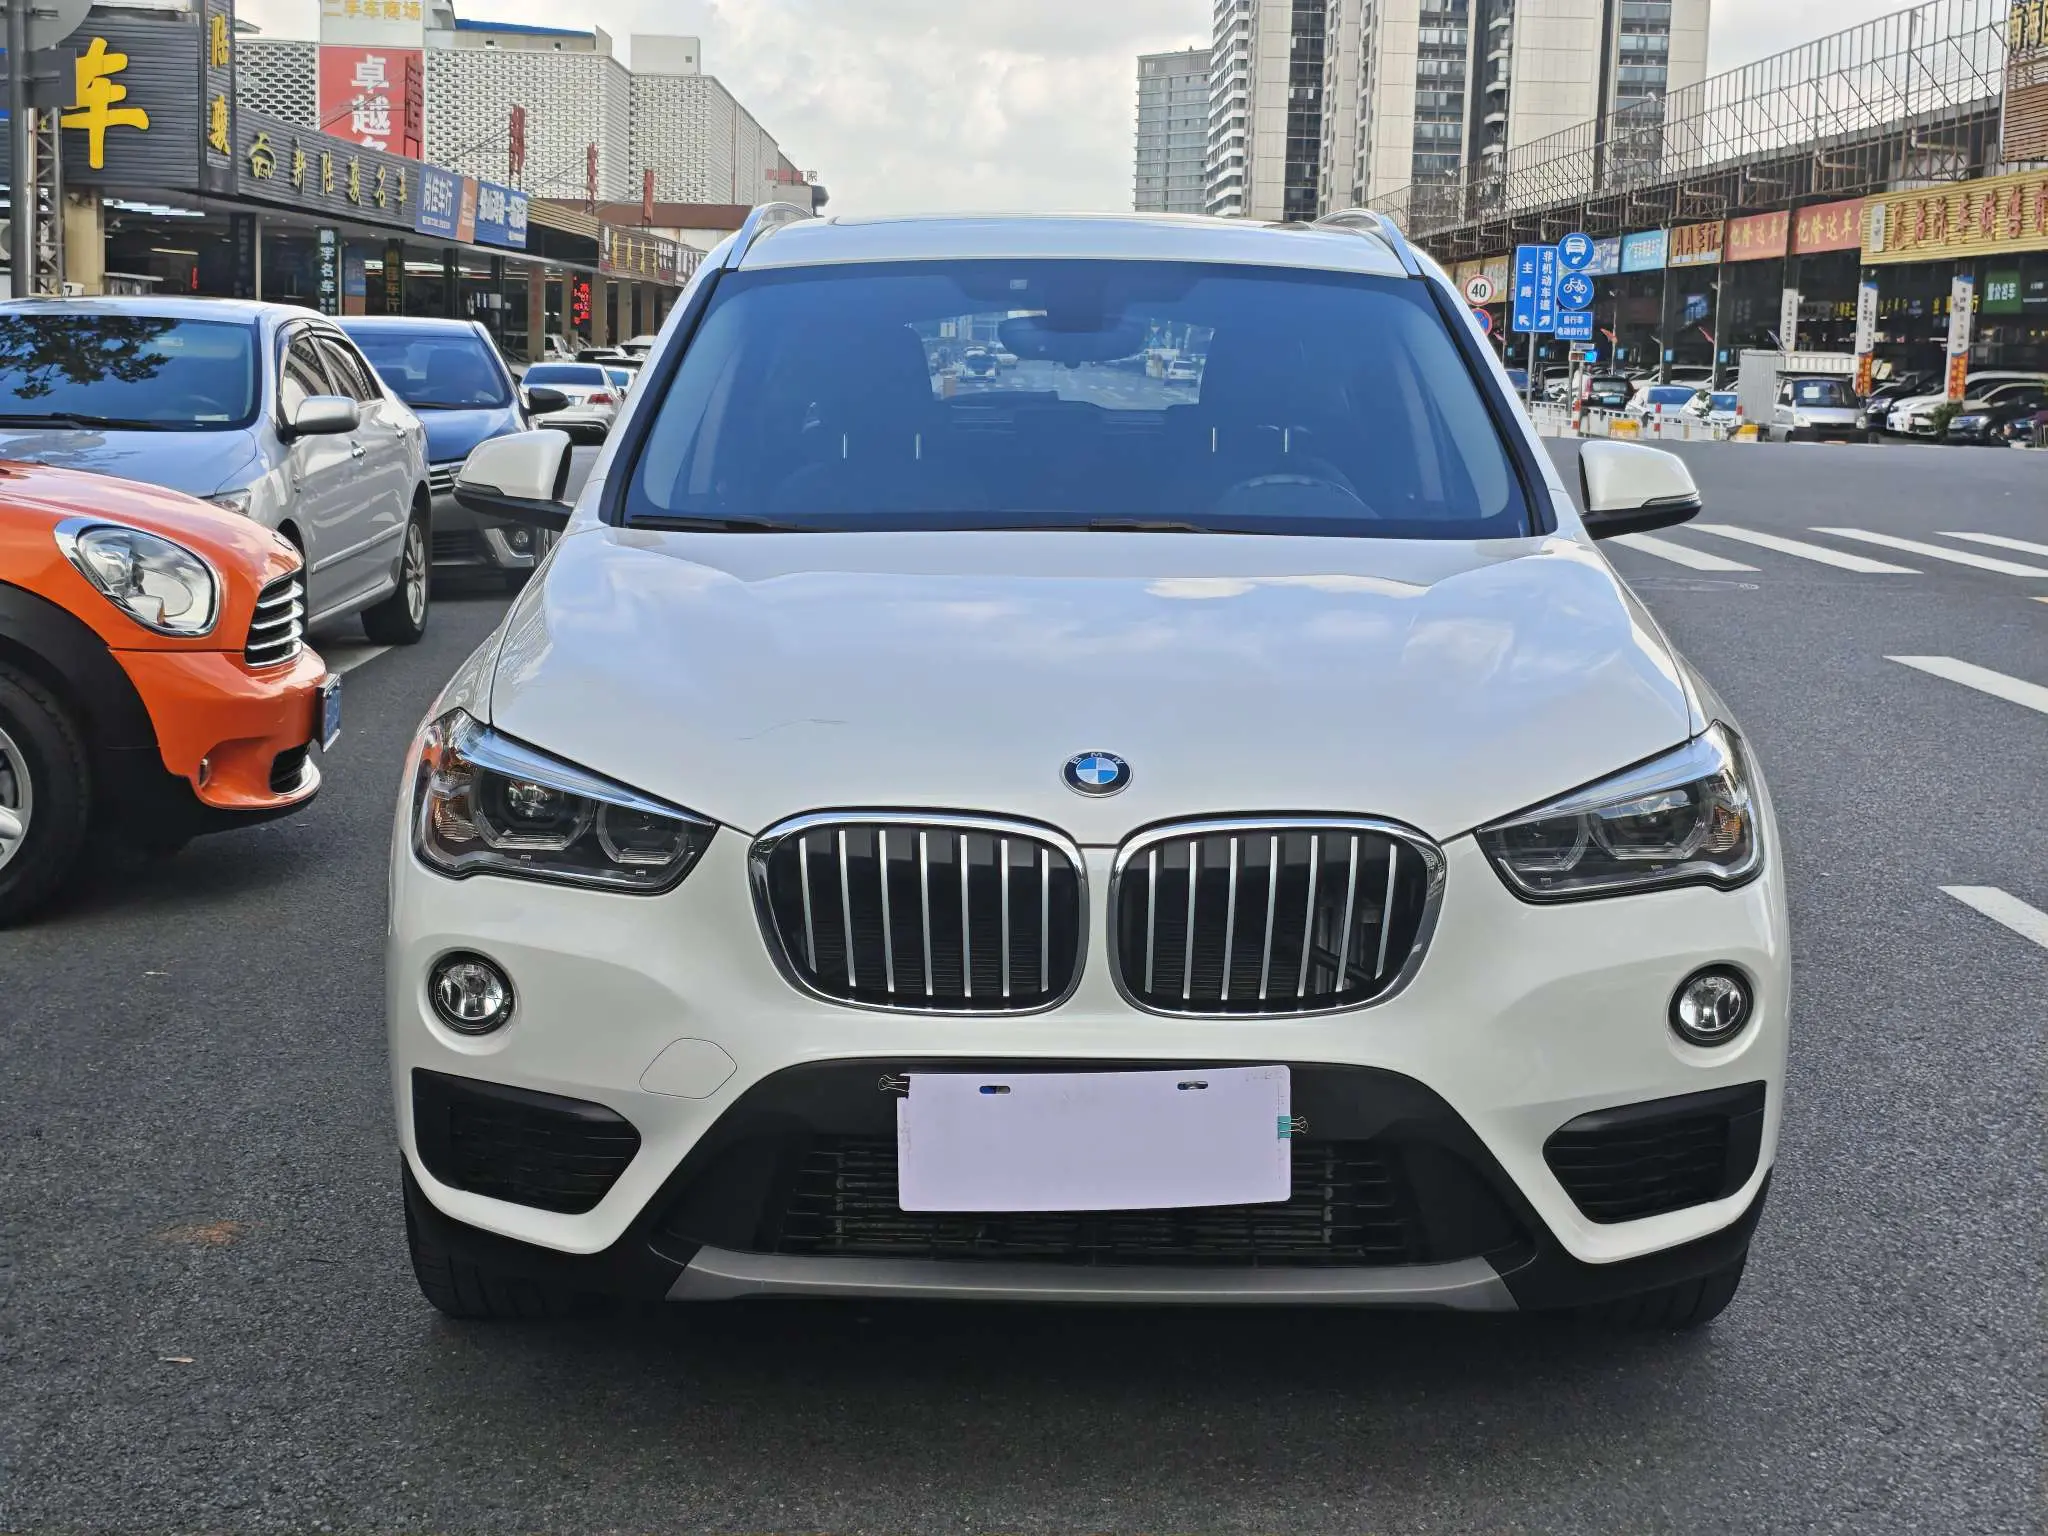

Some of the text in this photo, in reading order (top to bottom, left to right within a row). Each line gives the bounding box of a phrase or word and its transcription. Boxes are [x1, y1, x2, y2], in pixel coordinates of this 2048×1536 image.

[61, 37, 150, 170] 车
[1471, 283, 1487, 298] 40
[1521, 261, 1533, 298] 主路
[1540, 250, 1553, 311] 非机动车道
